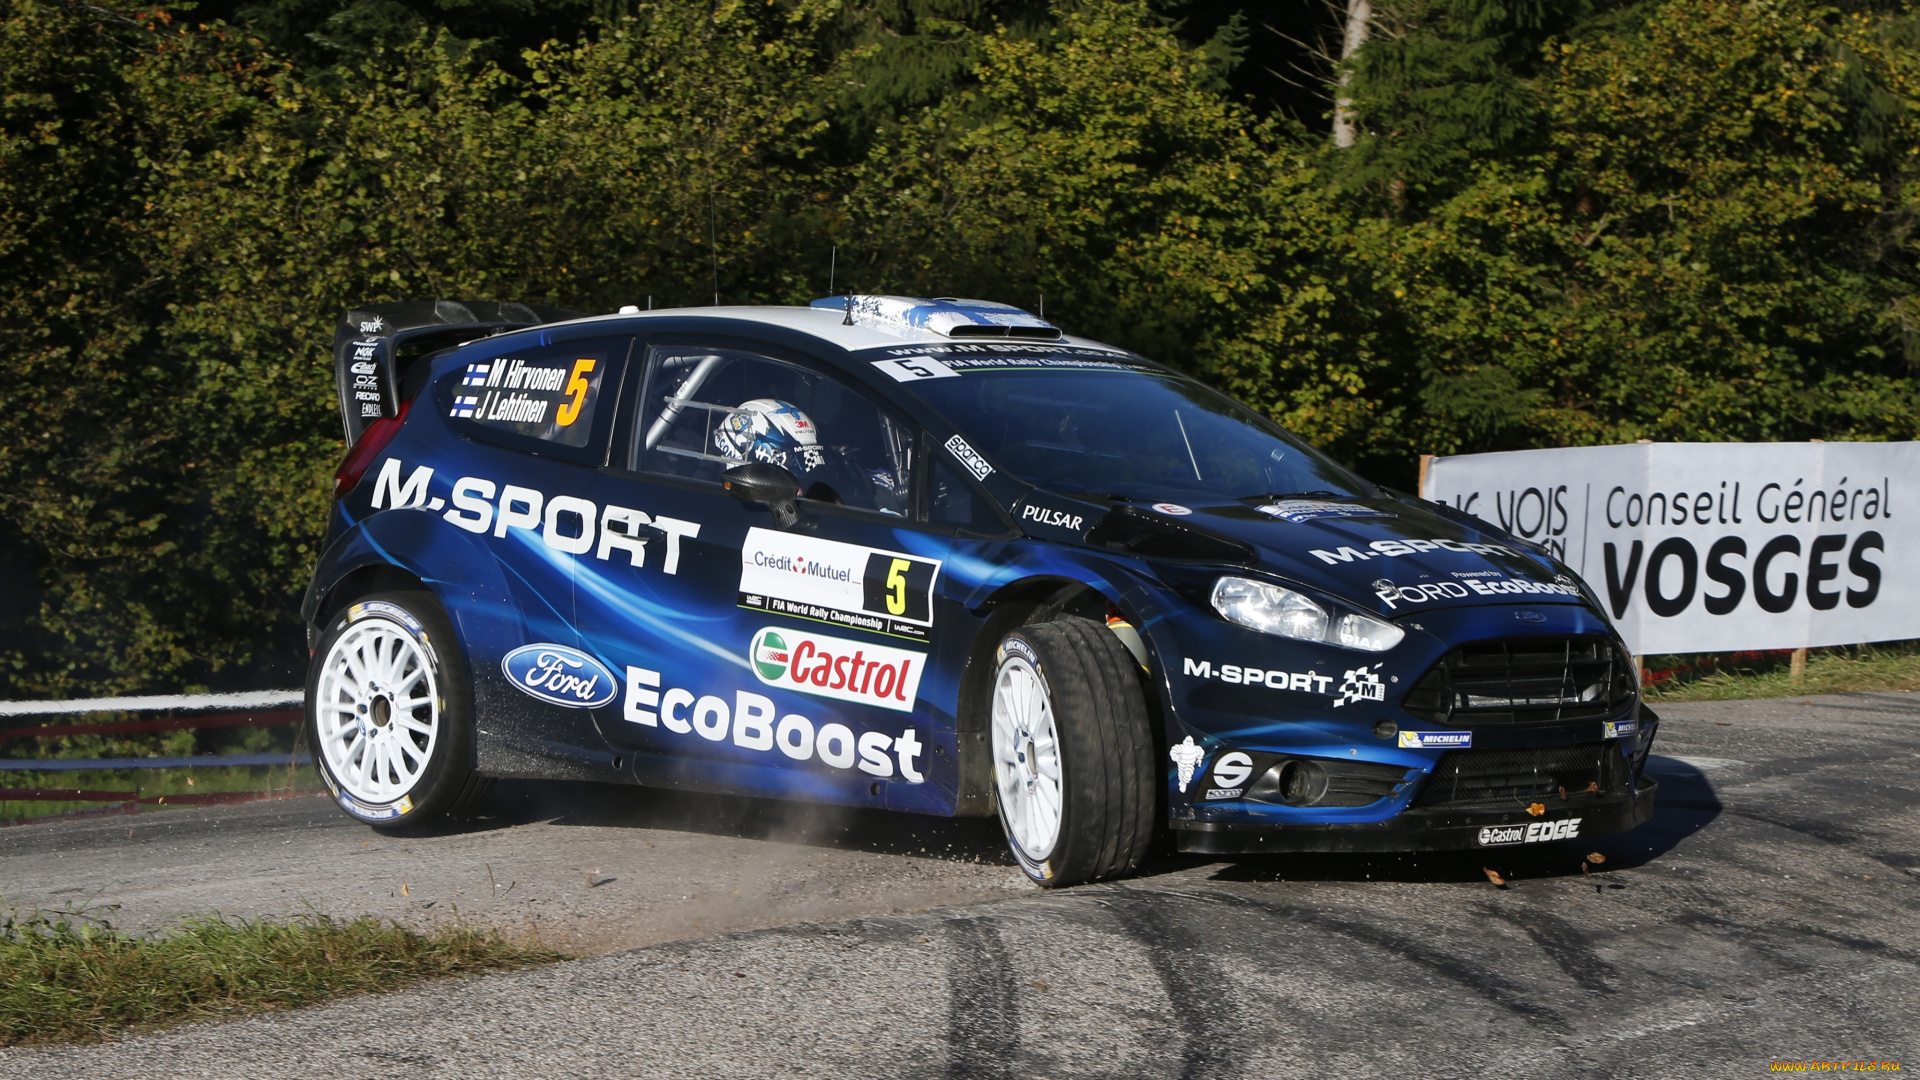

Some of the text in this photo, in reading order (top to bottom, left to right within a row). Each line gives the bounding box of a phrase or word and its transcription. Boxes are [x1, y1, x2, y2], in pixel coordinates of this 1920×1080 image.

[355, 347, 376, 357] NGK
[486, 358, 567, 392] M Hirvonen
[894, 360, 935, 377] 5
[475, 391, 548, 424] J Lehtinen
[555, 358, 597, 427] 5
[795, 420, 809, 429] 3M
[949, 437, 991, 475] sparco
[1022, 504, 1083, 531] PULSAR
[1496, 485, 1567, 539] VOIS
[1606, 477, 1892, 529] Conseil Général
[754, 551, 851, 583] Crédit Mutuel
[1450, 570, 1502, 579] Powered by
[1603, 530, 1885, 620] VOSGES
[886, 558, 911, 616] 5
[1375, 582, 1469, 610] FORD
[772, 600, 883, 631] FIA World Rally Championship
[1006, 640, 1036, 663] MICHELIN
[525, 651, 599, 700] Ford
[790, 640, 912, 702] Castrol
[1183, 657, 1334, 694] M-SPORT
[1361, 683, 1377, 698] M
[623, 665, 924, 784] EcoBoost
[1423, 735, 1470, 743] MICHELIN
[1490, 818, 1582, 843] Castrol EDGE
